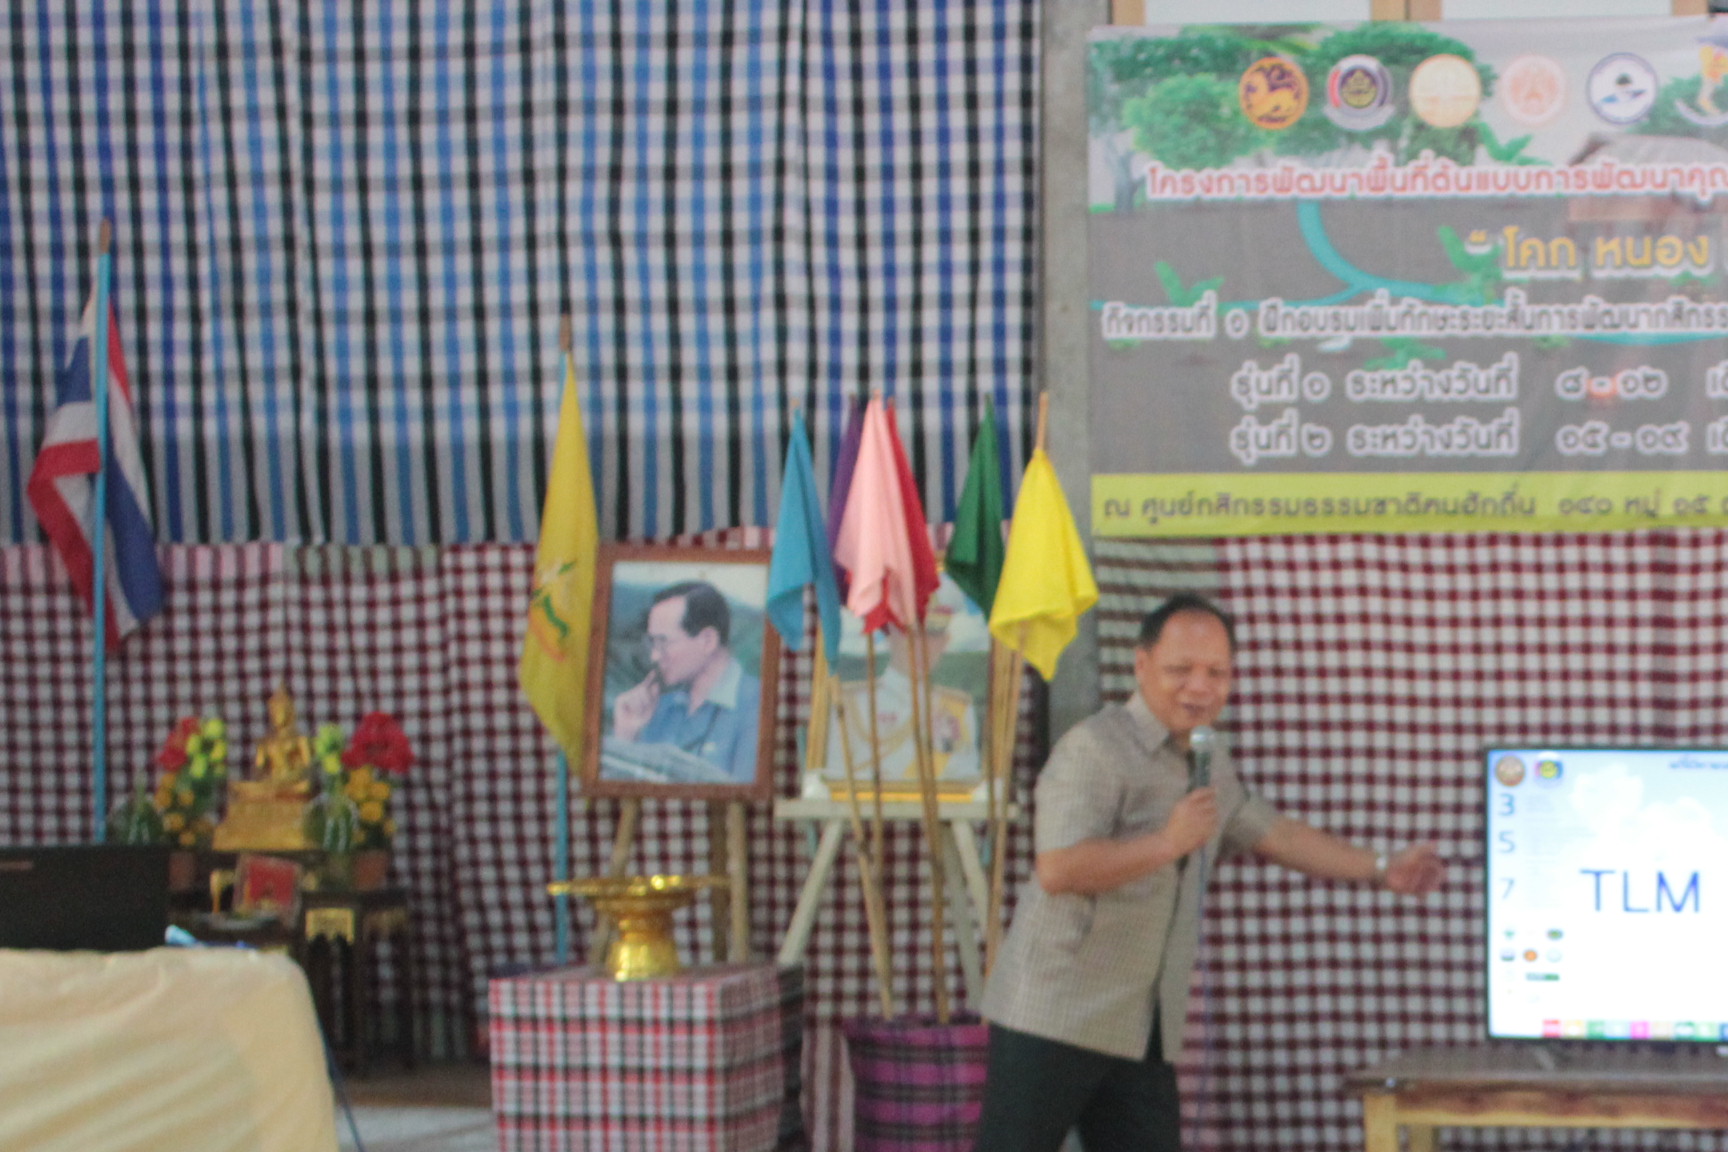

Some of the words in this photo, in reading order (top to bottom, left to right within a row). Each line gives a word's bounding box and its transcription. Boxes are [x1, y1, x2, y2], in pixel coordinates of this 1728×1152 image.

[1503, 225, 1577, 268] โคก
[1595, 233, 1710, 268] หนอง
[1103, 292, 1216, 338] กิจกรรมที่
[1232, 354, 1298, 408] รุ่นที่
[1304, 373, 1330, 400] ๑
[1347, 353, 1518, 400] ระหว่างวันที่
[1231, 408, 1297, 463] รุ่นที่
[1304, 425, 1331, 455] ๒
[1347, 408, 1518, 456] ระหว่างวันที่
[1103, 498, 1132, 519] ณ
[1624, 488, 1663, 519] หมู่
[1498, 793, 1516, 817] 3
[1498, 831, 1515, 854] 5
[1500, 878, 1515, 900] 7
[1579, 869, 1700, 913] TLM
